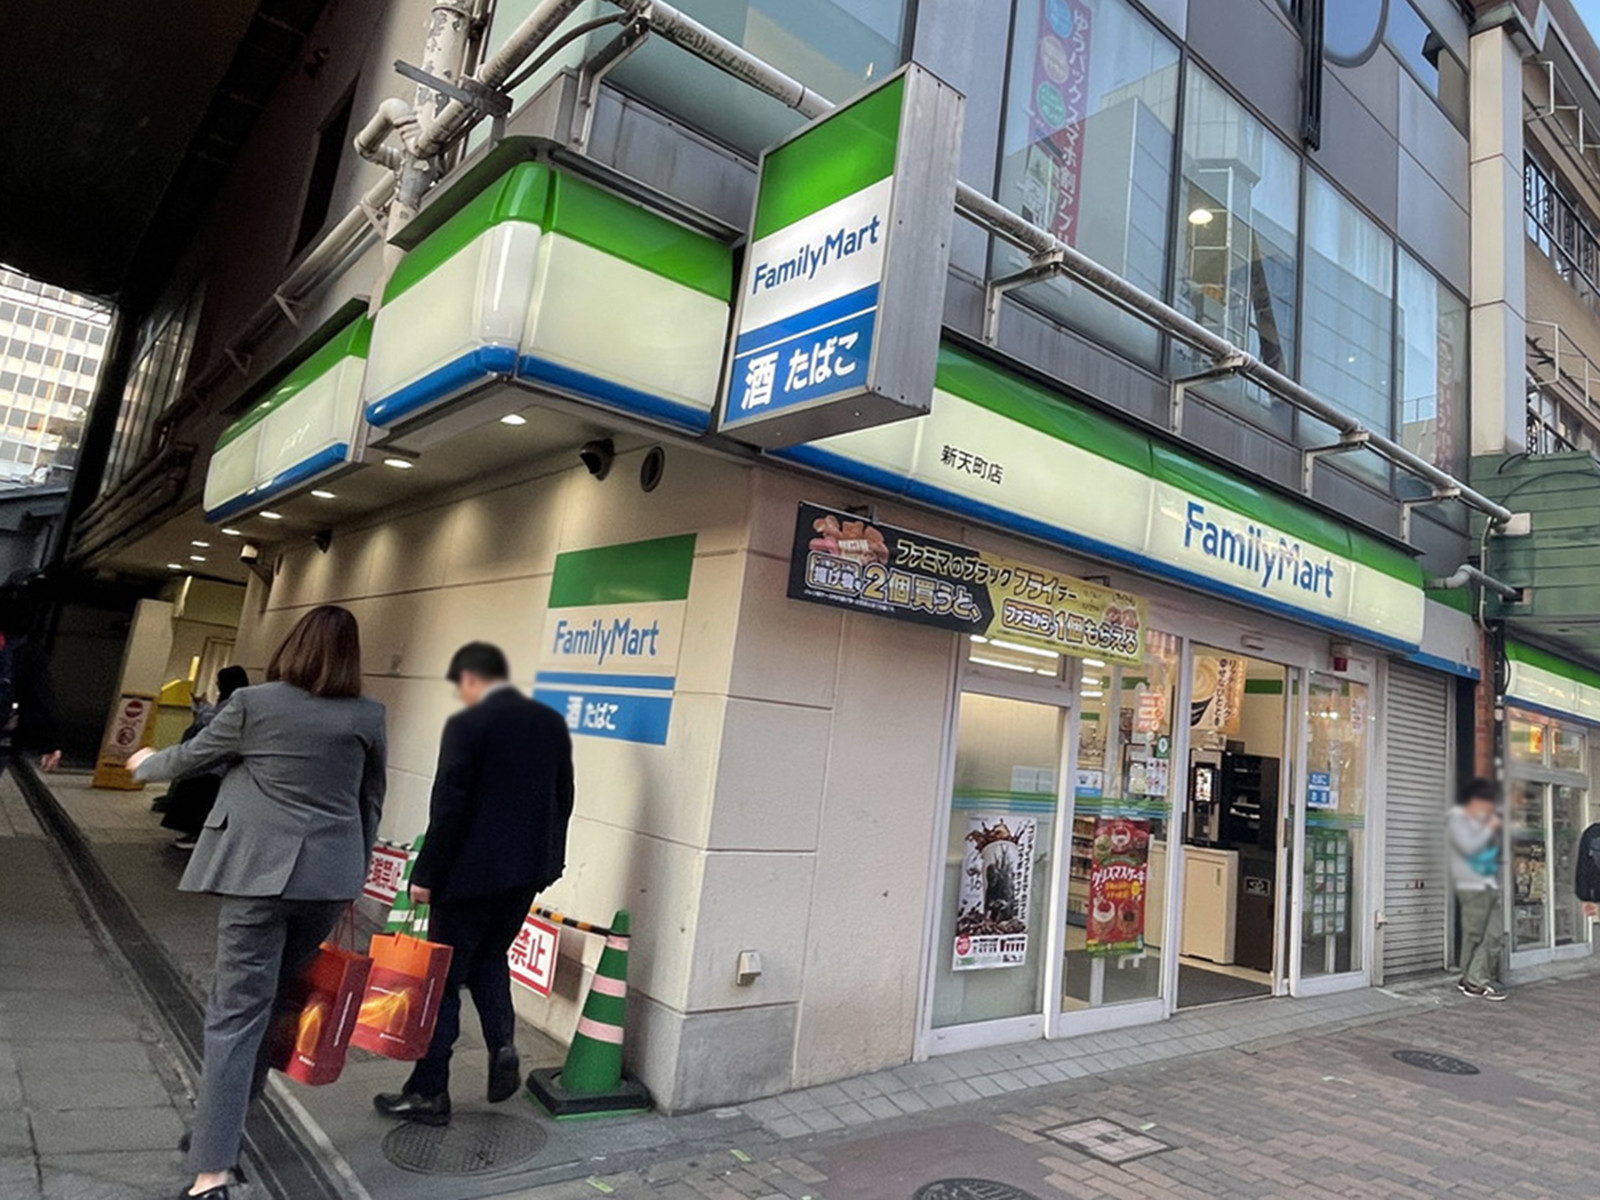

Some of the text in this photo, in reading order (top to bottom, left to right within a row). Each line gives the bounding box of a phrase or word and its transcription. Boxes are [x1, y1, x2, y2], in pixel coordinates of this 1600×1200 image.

[752, 214, 881, 295] FamilyMart
[741, 332, 860, 410] 酒 たばこ
[940, 444, 1005, 485] 新天町店
[1183, 500, 1335, 599] FamilyMart
[552, 617, 659, 665] FamilyMart
[583, 702, 619, 730] たばこ
[1091, 865, 1146, 888] クリスマスケーキ
